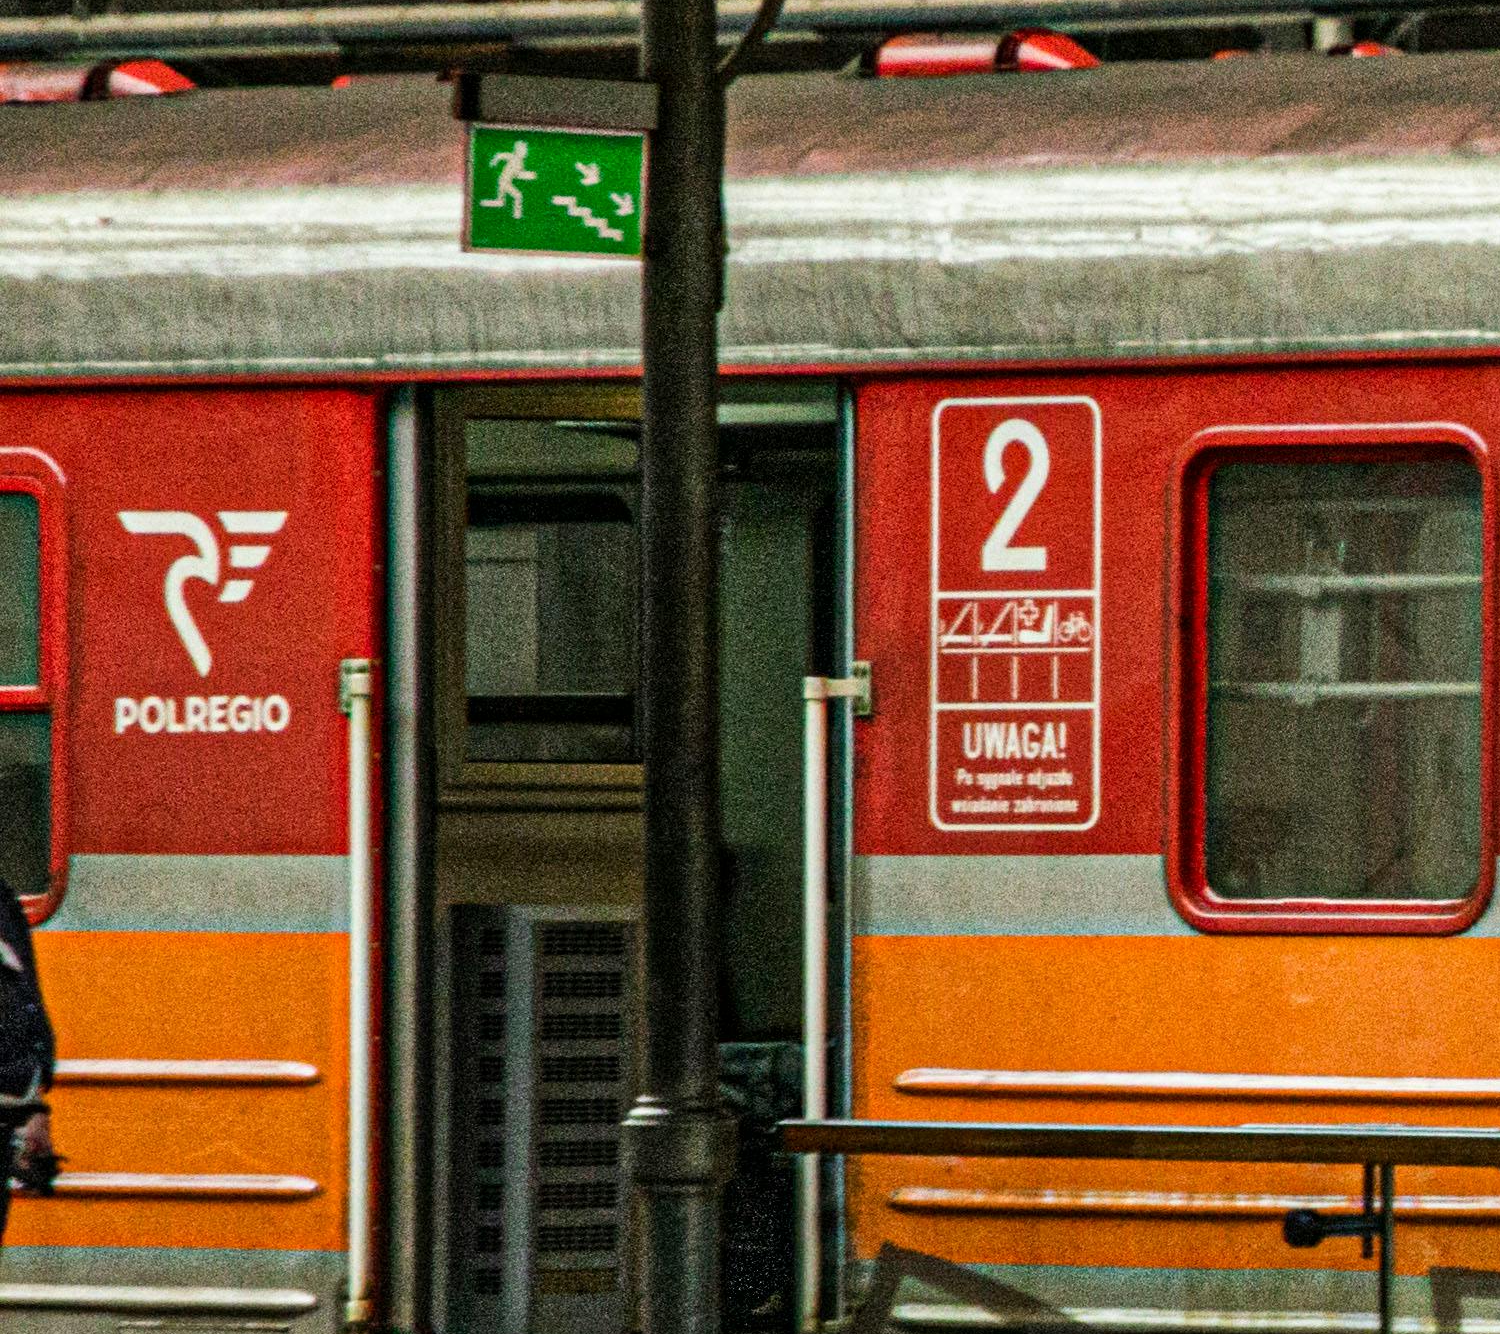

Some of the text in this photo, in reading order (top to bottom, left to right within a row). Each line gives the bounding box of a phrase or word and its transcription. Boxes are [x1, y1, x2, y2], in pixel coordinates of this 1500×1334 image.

[980, 417, 1051, 573] 2
[114, 694, 291, 734] POLREGIO
[963, 721, 1068, 760] UWAGA!
